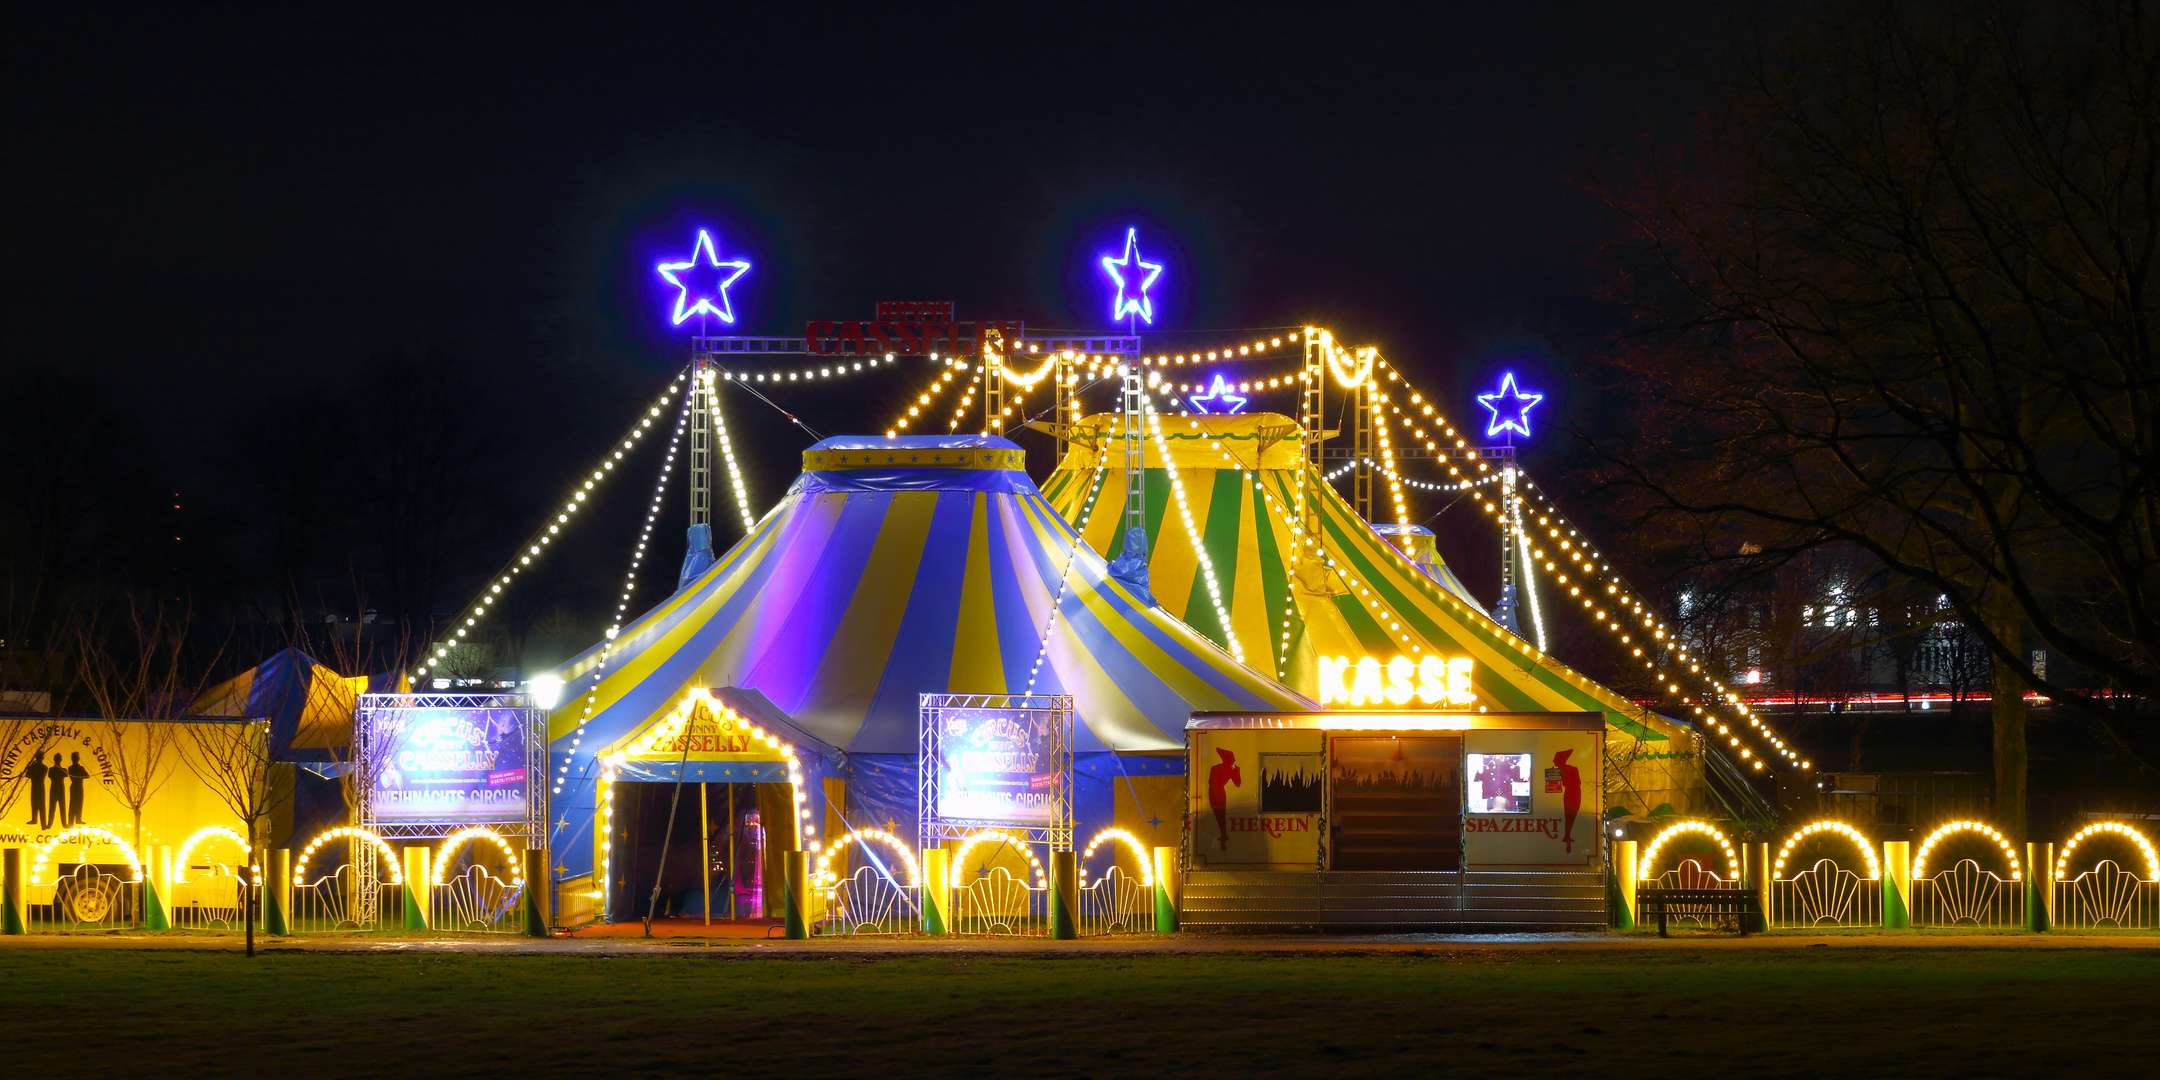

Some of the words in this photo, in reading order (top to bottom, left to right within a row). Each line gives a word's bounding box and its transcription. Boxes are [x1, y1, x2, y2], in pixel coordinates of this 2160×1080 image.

[877, 302, 953, 321] JONNY
[806, 320, 1023, 356] CASSELLY
[1318, 655, 1473, 705] KASSE
[22, 725, 81, 746] CASSELLY
[82, 736, 92, 747] &
[410, 717, 485, 747] CIRCUS
[684, 724, 718, 734] JONNY
[970, 718, 1028, 747] CIRCUS
[400, 750, 499, 771] CASSELLY
[377, 789, 521, 804] WEIHNACHTS-CIRCUS
[1229, 813, 1315, 839] HEREIN
[1466, 818, 1562, 839] SPAZIERT
